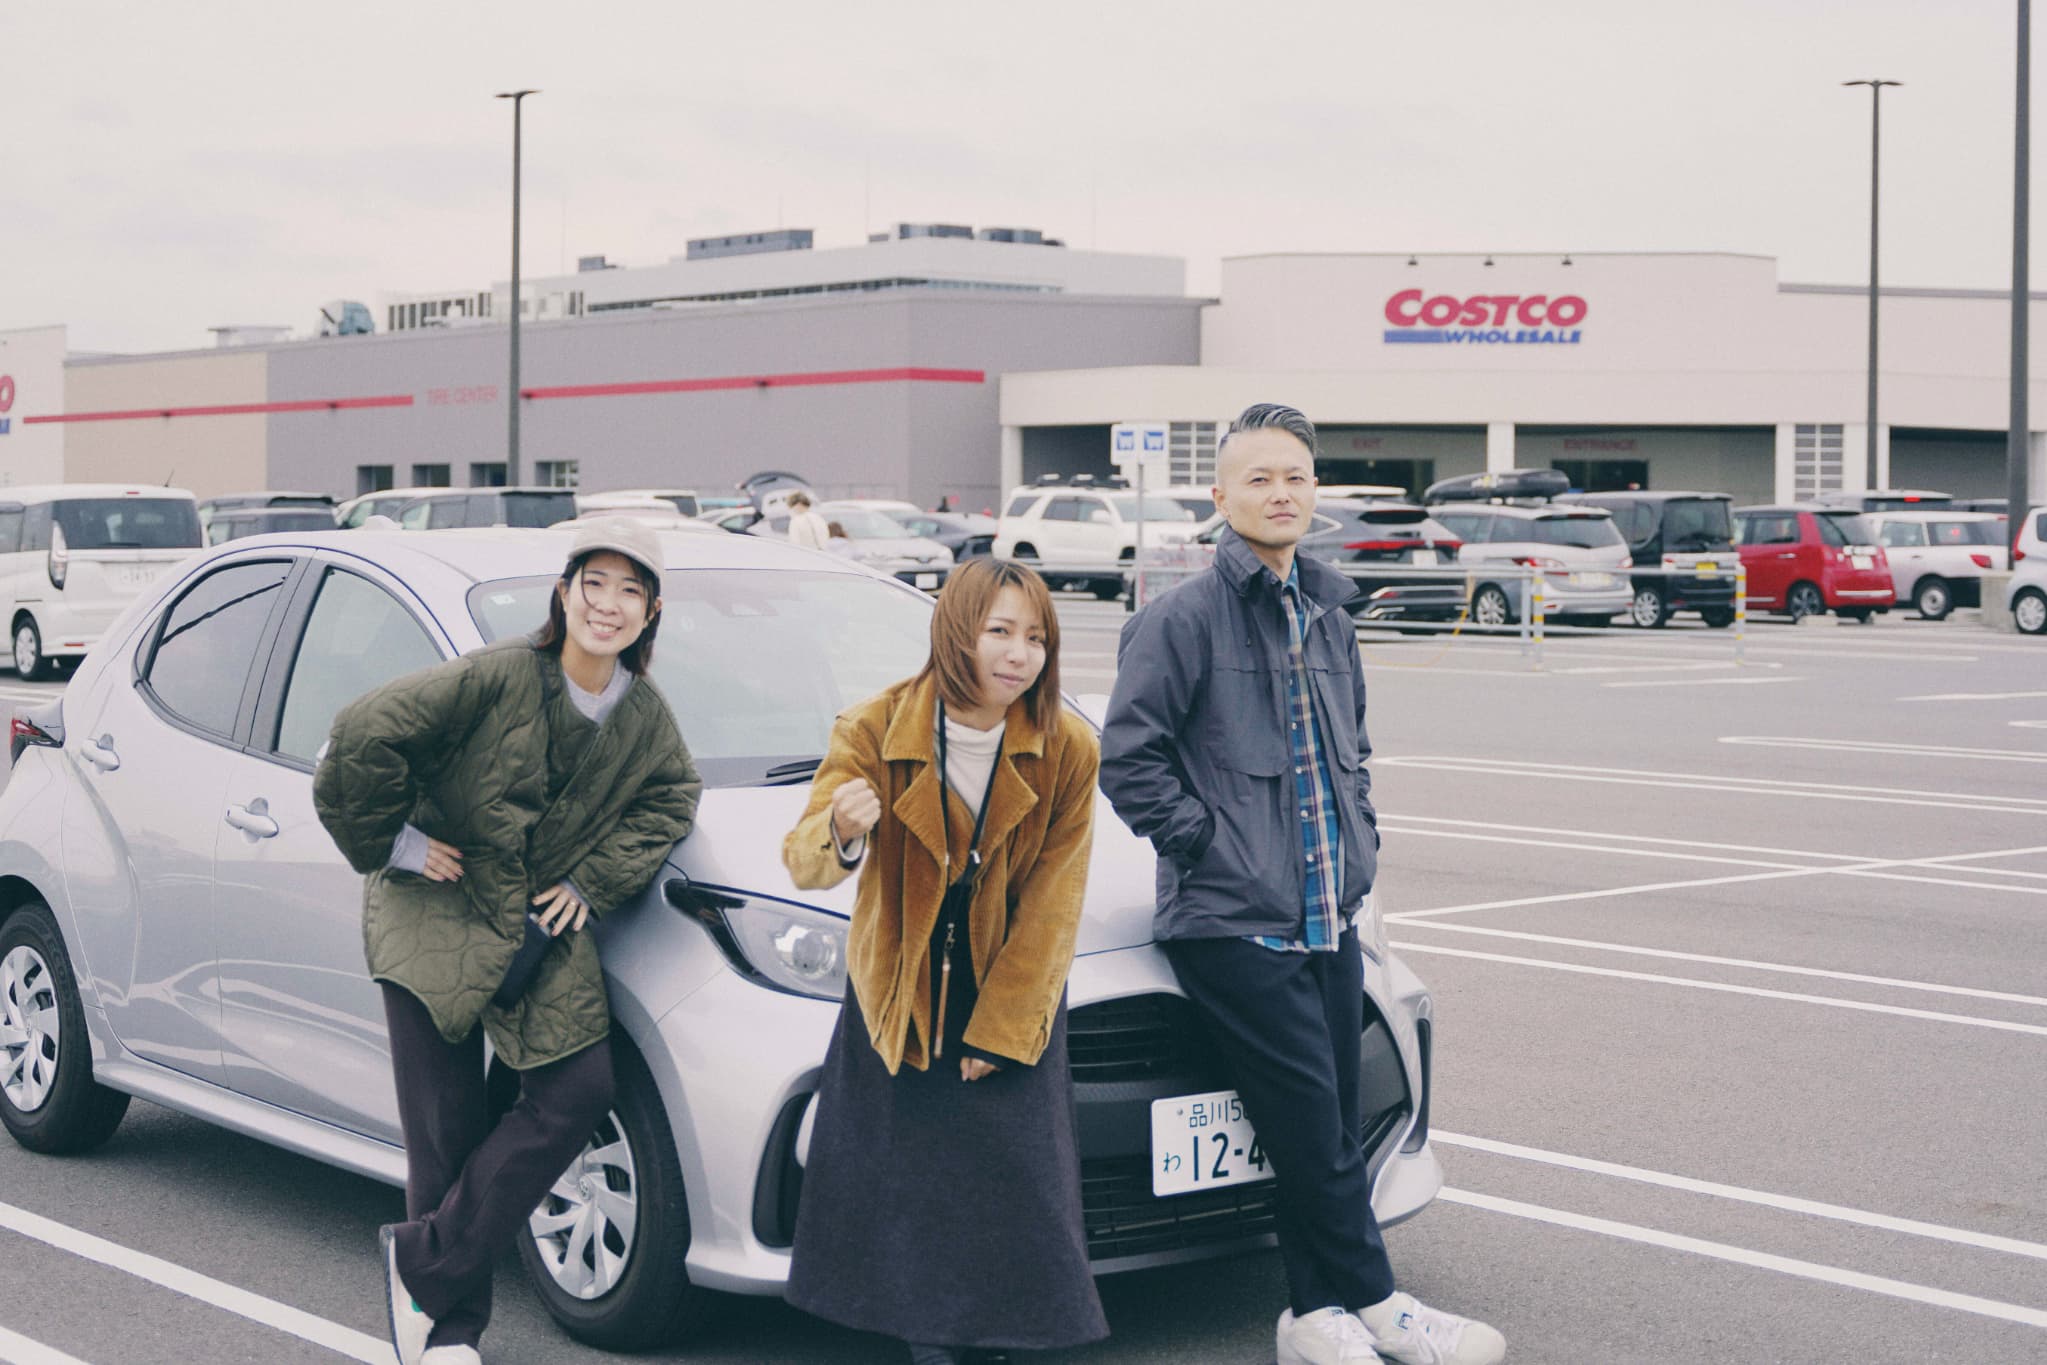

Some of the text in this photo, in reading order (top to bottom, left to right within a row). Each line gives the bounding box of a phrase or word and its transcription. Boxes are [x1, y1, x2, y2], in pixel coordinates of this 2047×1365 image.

[1384, 289, 1588, 327] COSTCO
[1442, 330, 1582, 344] WHOLESALE
[1189, 1098, 1248, 1128] 品川5
[1163, 1131, 1266, 1182] わ 12-4
